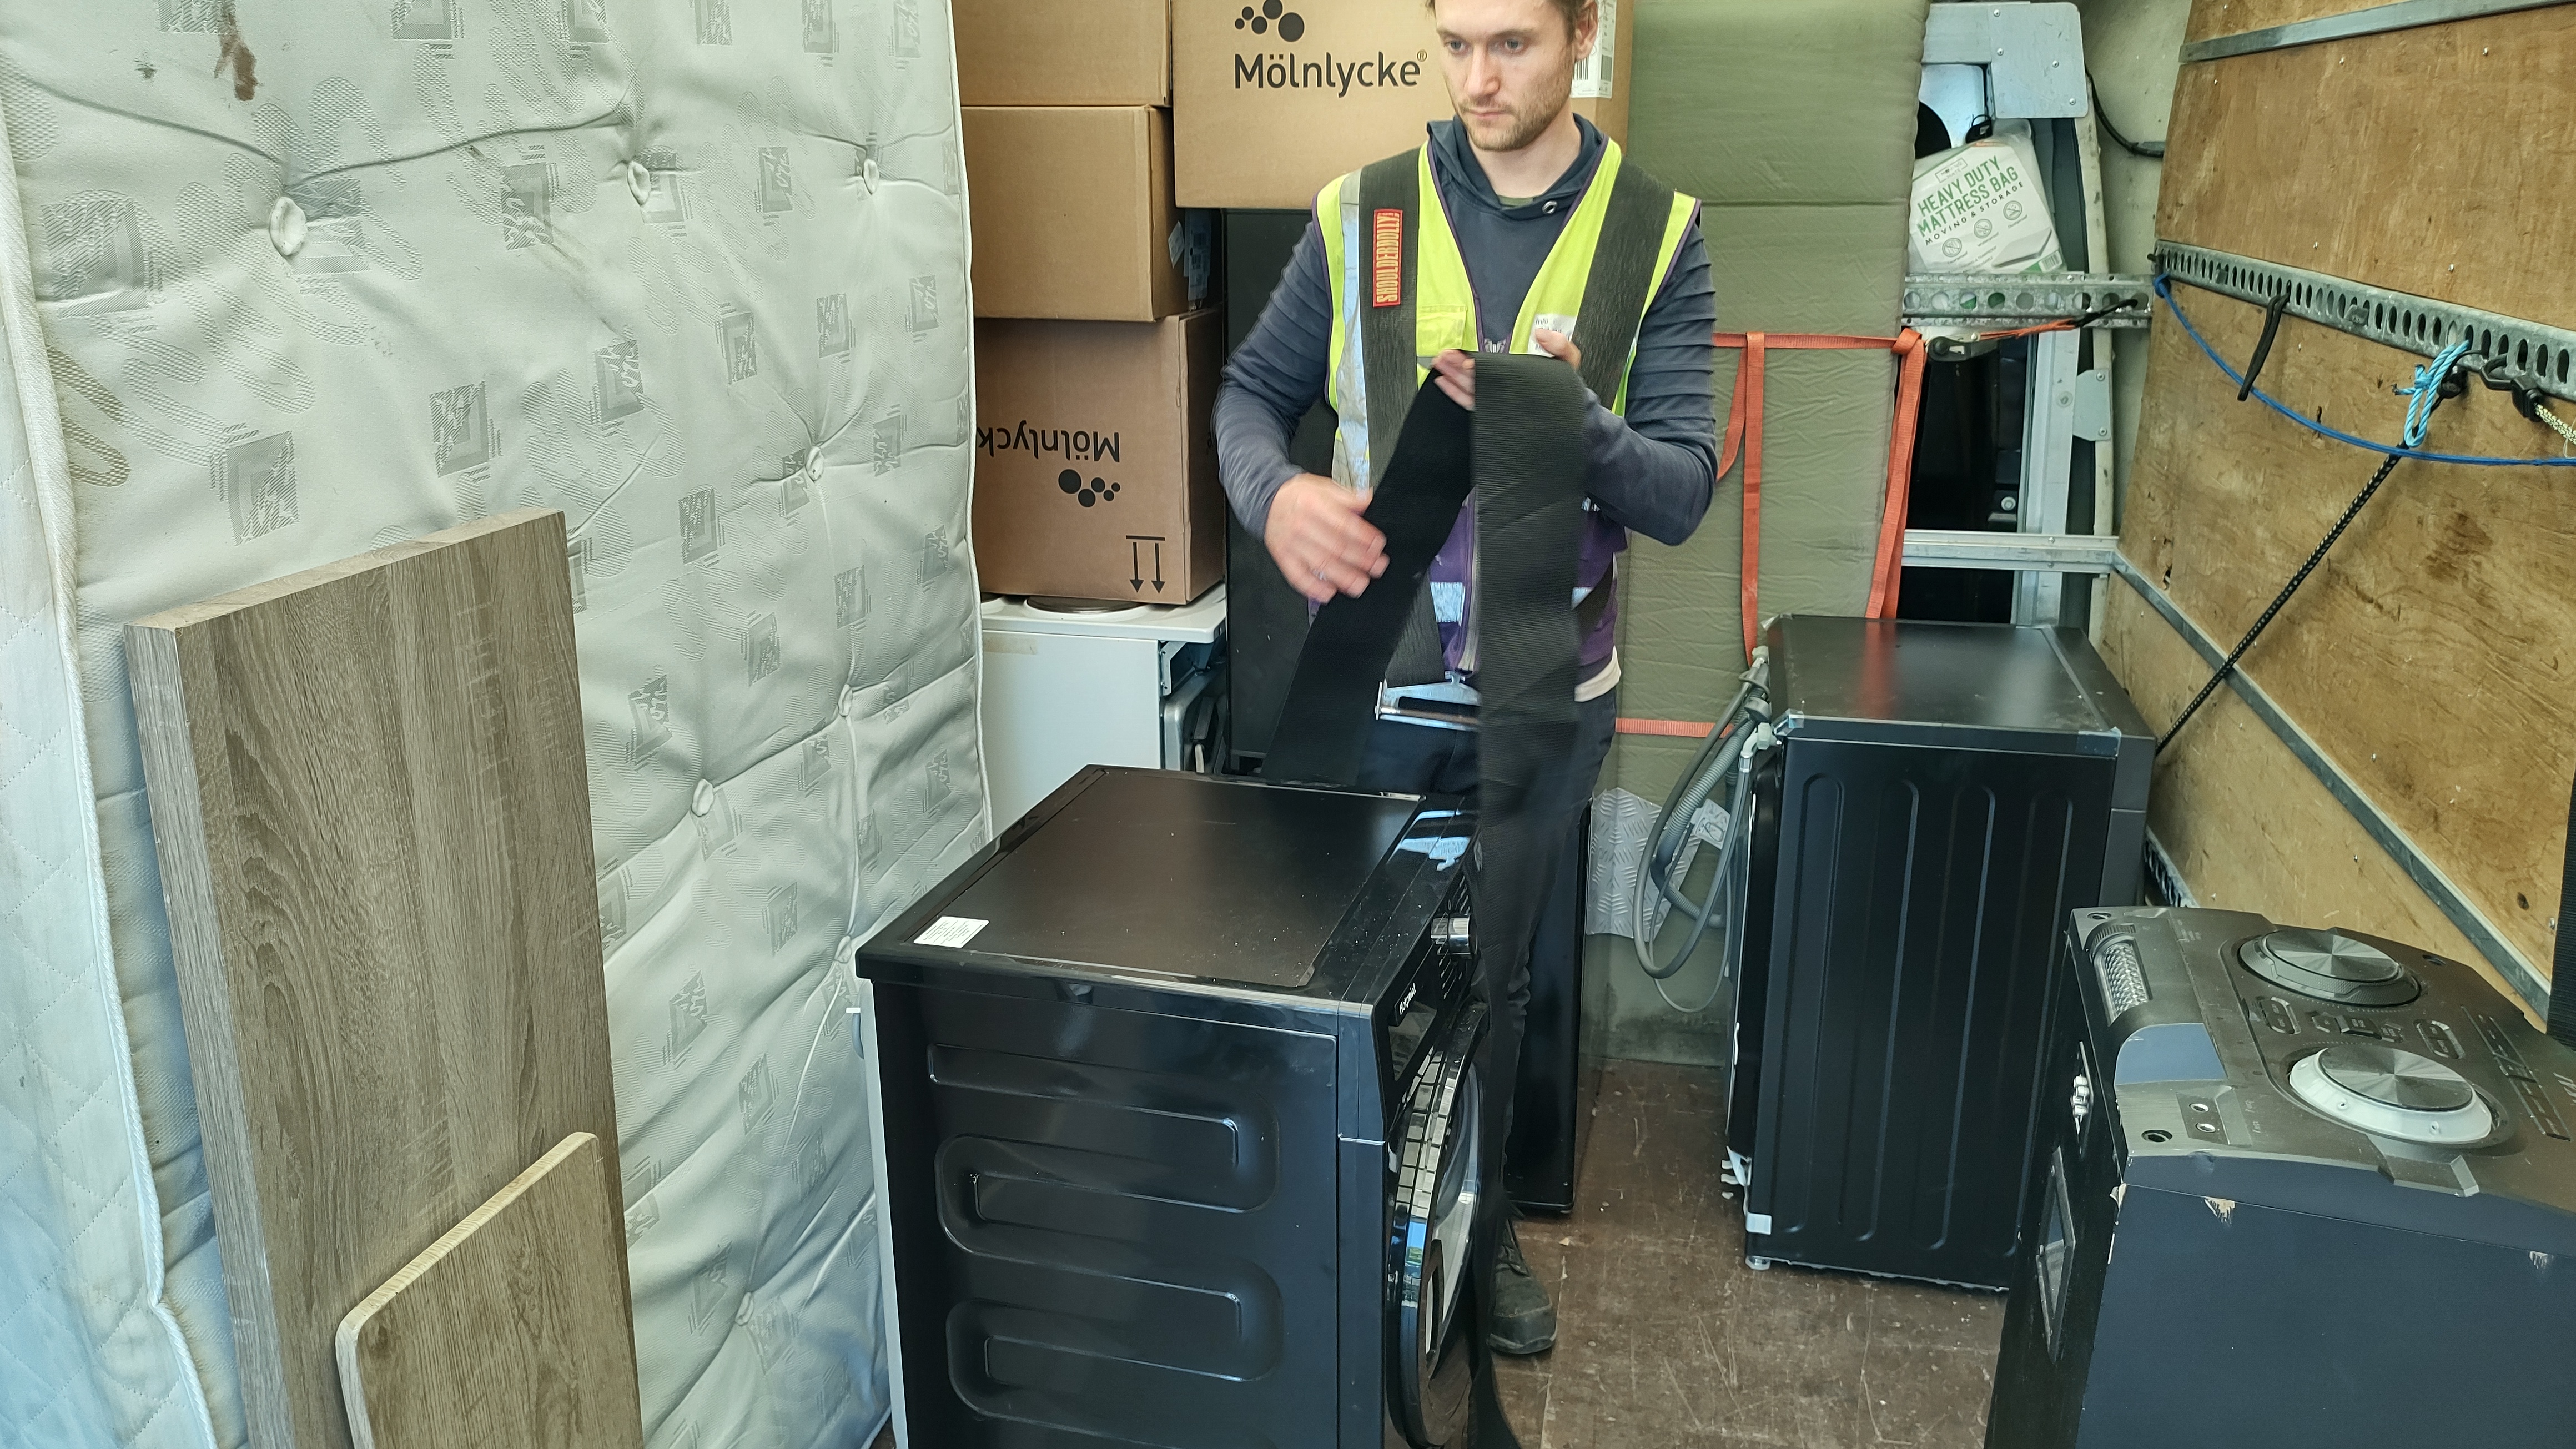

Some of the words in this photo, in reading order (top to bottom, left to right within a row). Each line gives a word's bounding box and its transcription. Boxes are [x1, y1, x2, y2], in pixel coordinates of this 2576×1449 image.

[1916, 184, 1990, 238] MATTRESS
[1989, 166, 2019, 192] BAG
[1917, 178, 1963, 217] HEAVY
[1964, 155, 2000, 188] DUTY
[1925, 217, 1967, 246] MOVING
[1980, 182, 2024, 212] STORAGE
[1399, 982, 1417, 1015] Hotpoint
